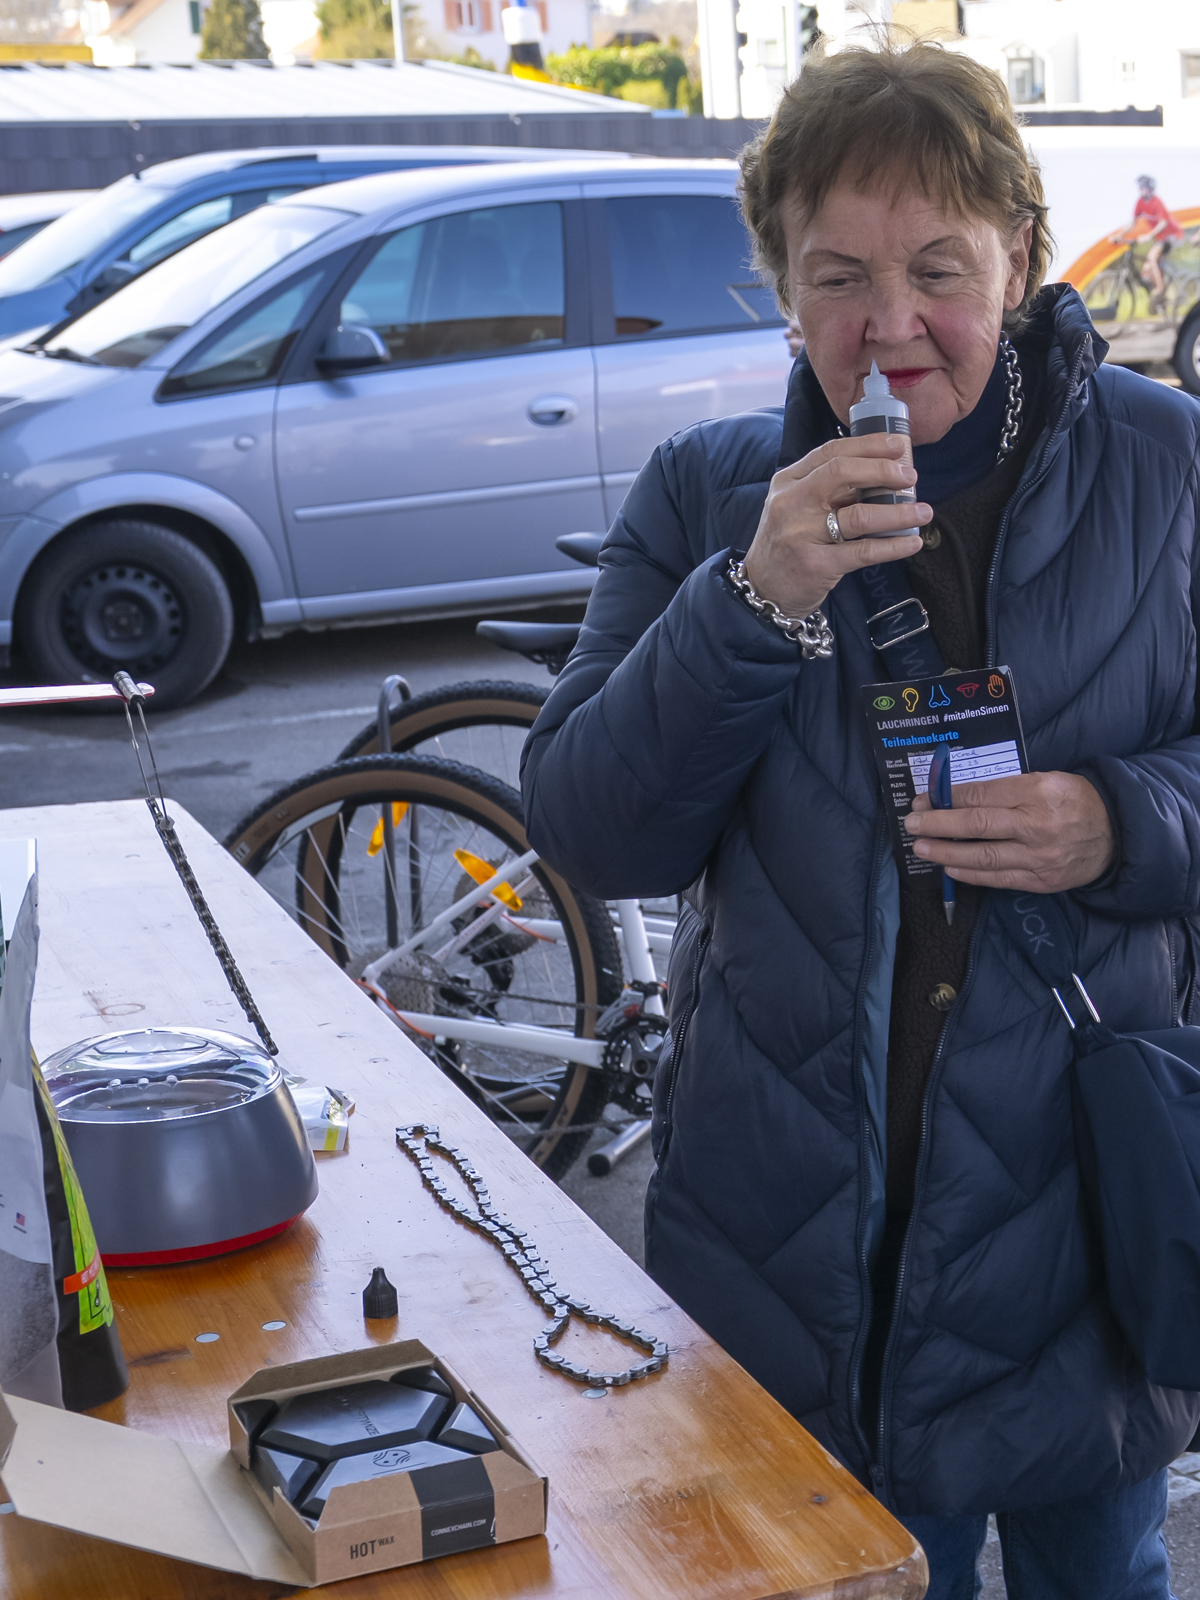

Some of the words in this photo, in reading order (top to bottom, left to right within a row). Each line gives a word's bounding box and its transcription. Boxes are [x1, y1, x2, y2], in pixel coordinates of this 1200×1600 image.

[877, 714, 940, 731] LAUCHRINGEN
[943, 704, 1009, 723] #mitallenSinnen
[881, 731, 959, 748] Teilnahmekarte
[431, 1518, 487, 1537] CONNEXCHAIN.COM
[350, 1539, 377, 1560] HOT
[377, 1535, 395, 1547] WAX
